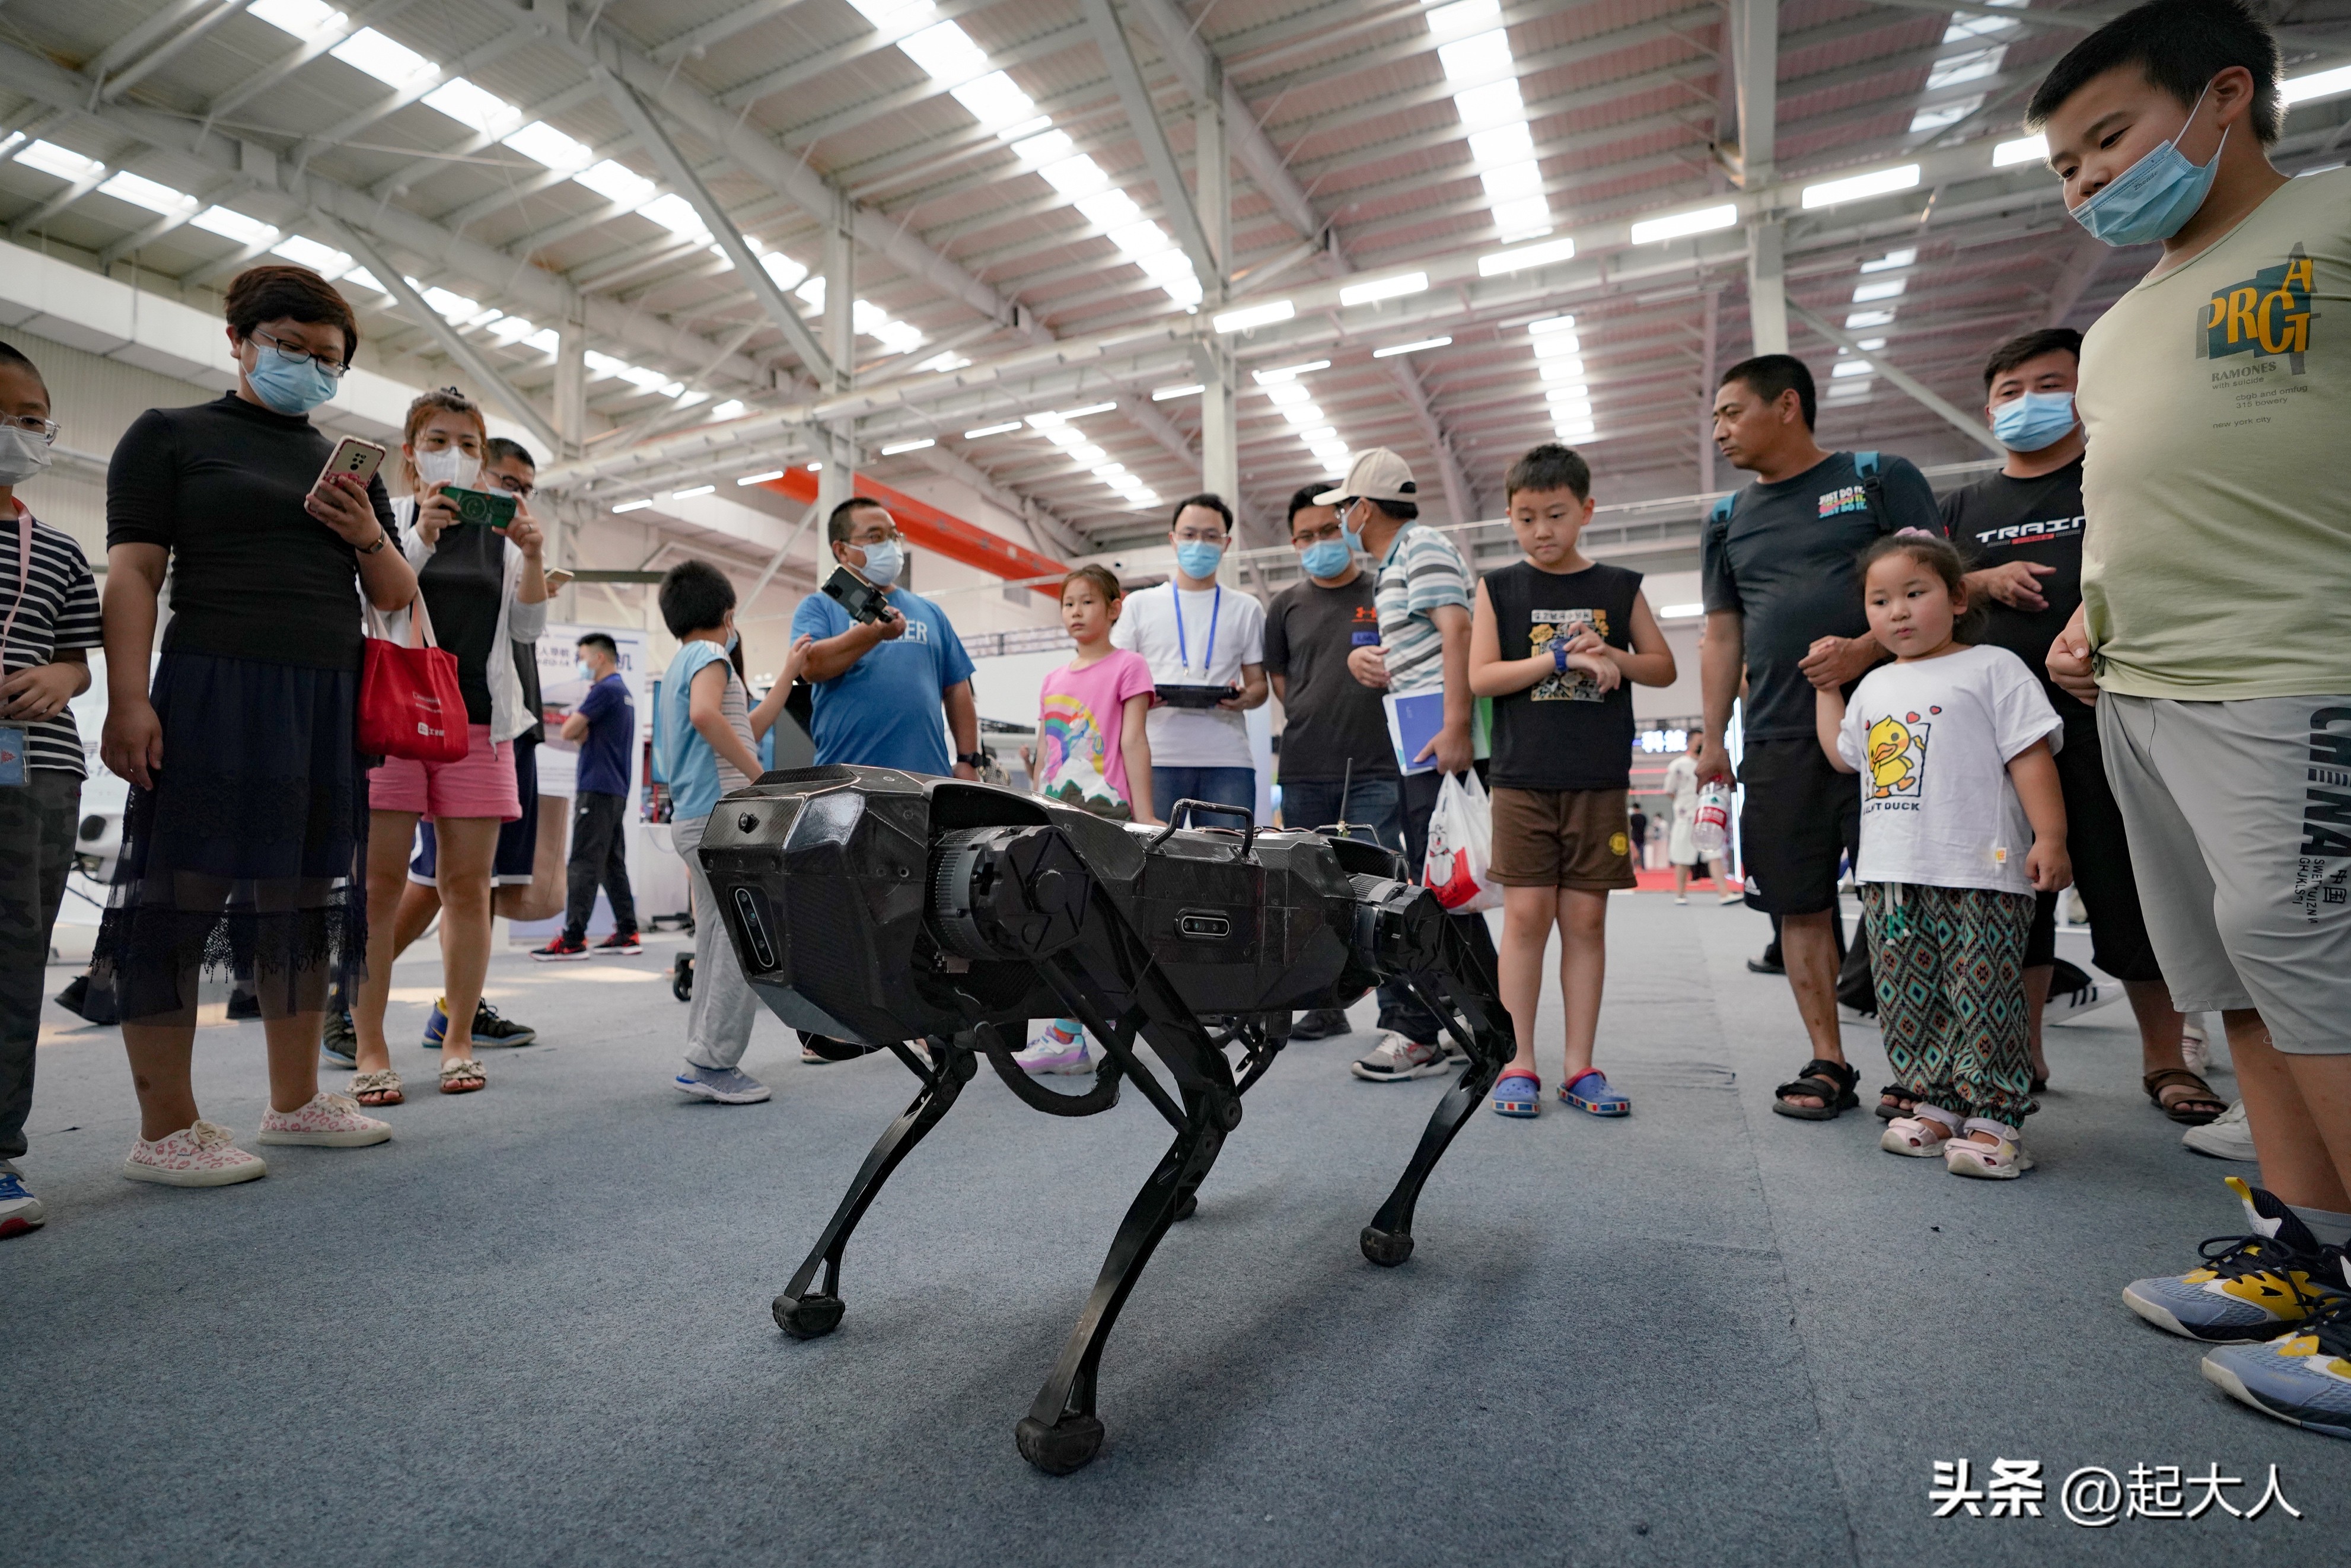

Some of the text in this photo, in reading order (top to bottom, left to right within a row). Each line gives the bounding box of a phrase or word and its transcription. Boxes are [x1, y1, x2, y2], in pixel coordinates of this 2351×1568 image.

[2212, 361, 2277, 382] RAMONES
[2233, 377, 2264, 387] suicide
[2235, 393, 2257, 401] cbgb
[2279, 385, 2308, 394] omfug
[2256, 397, 2288, 407] bowery
[2234, 418, 2253, 428] york
[2256, 416, 2272, 424] city
[1818, 490, 1839, 505] JUST
[1839, 486, 1853, 499] DO
[1884, 802, 1920, 811] DUCK
